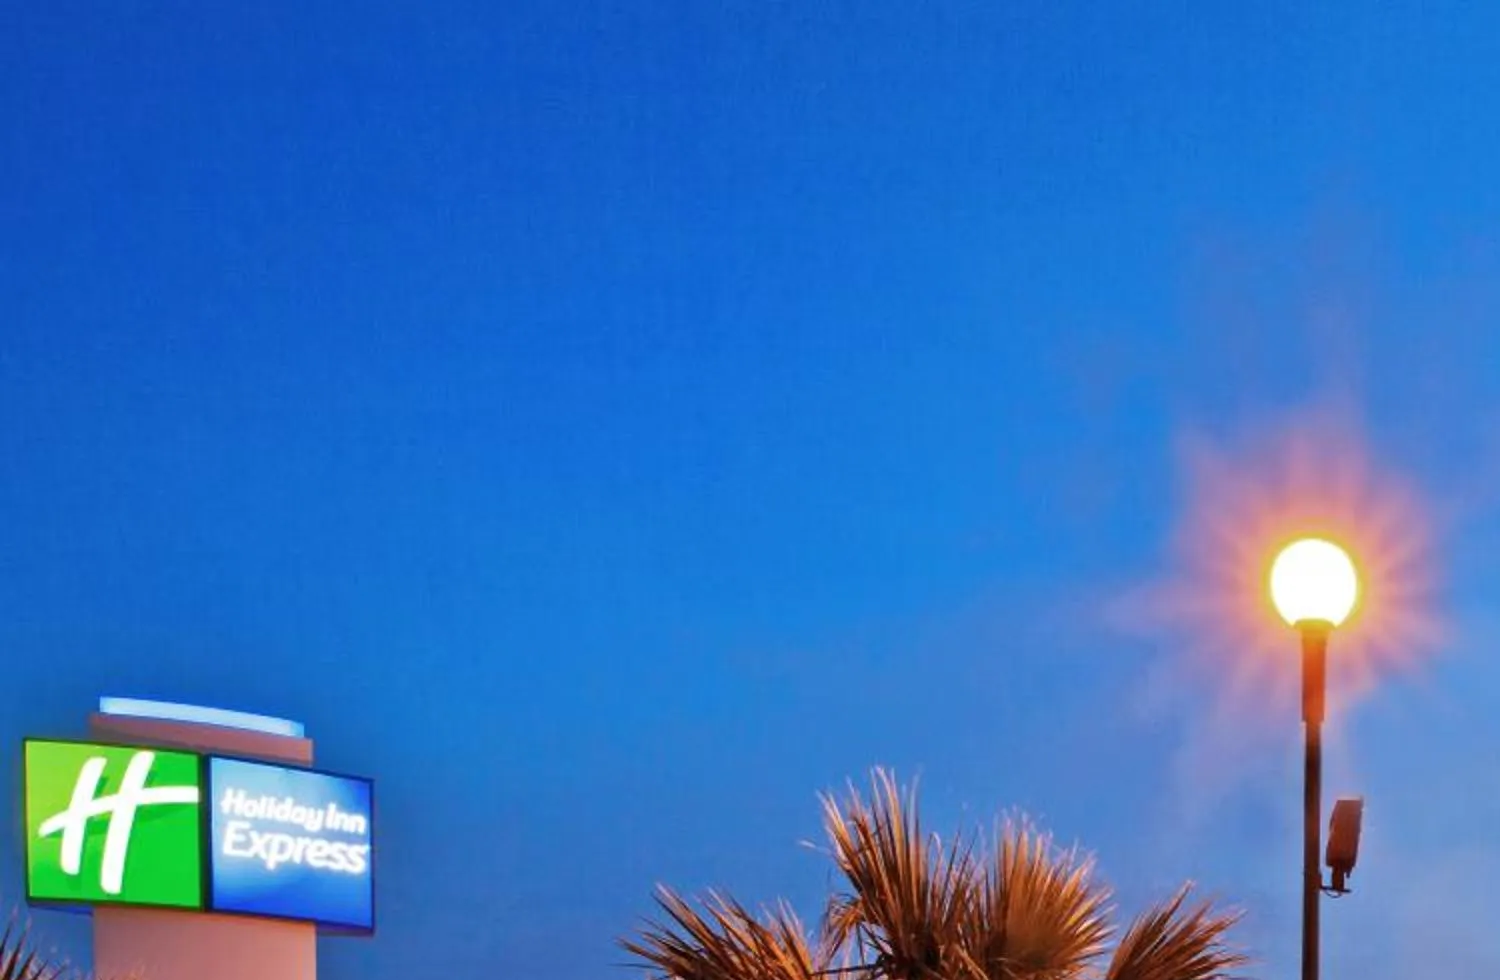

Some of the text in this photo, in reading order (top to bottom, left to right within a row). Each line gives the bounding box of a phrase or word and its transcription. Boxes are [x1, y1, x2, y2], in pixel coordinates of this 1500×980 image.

[39, 751, 199, 894] H
[220, 787, 367, 834] Holiday Inn
[222, 820, 371, 874] Express
